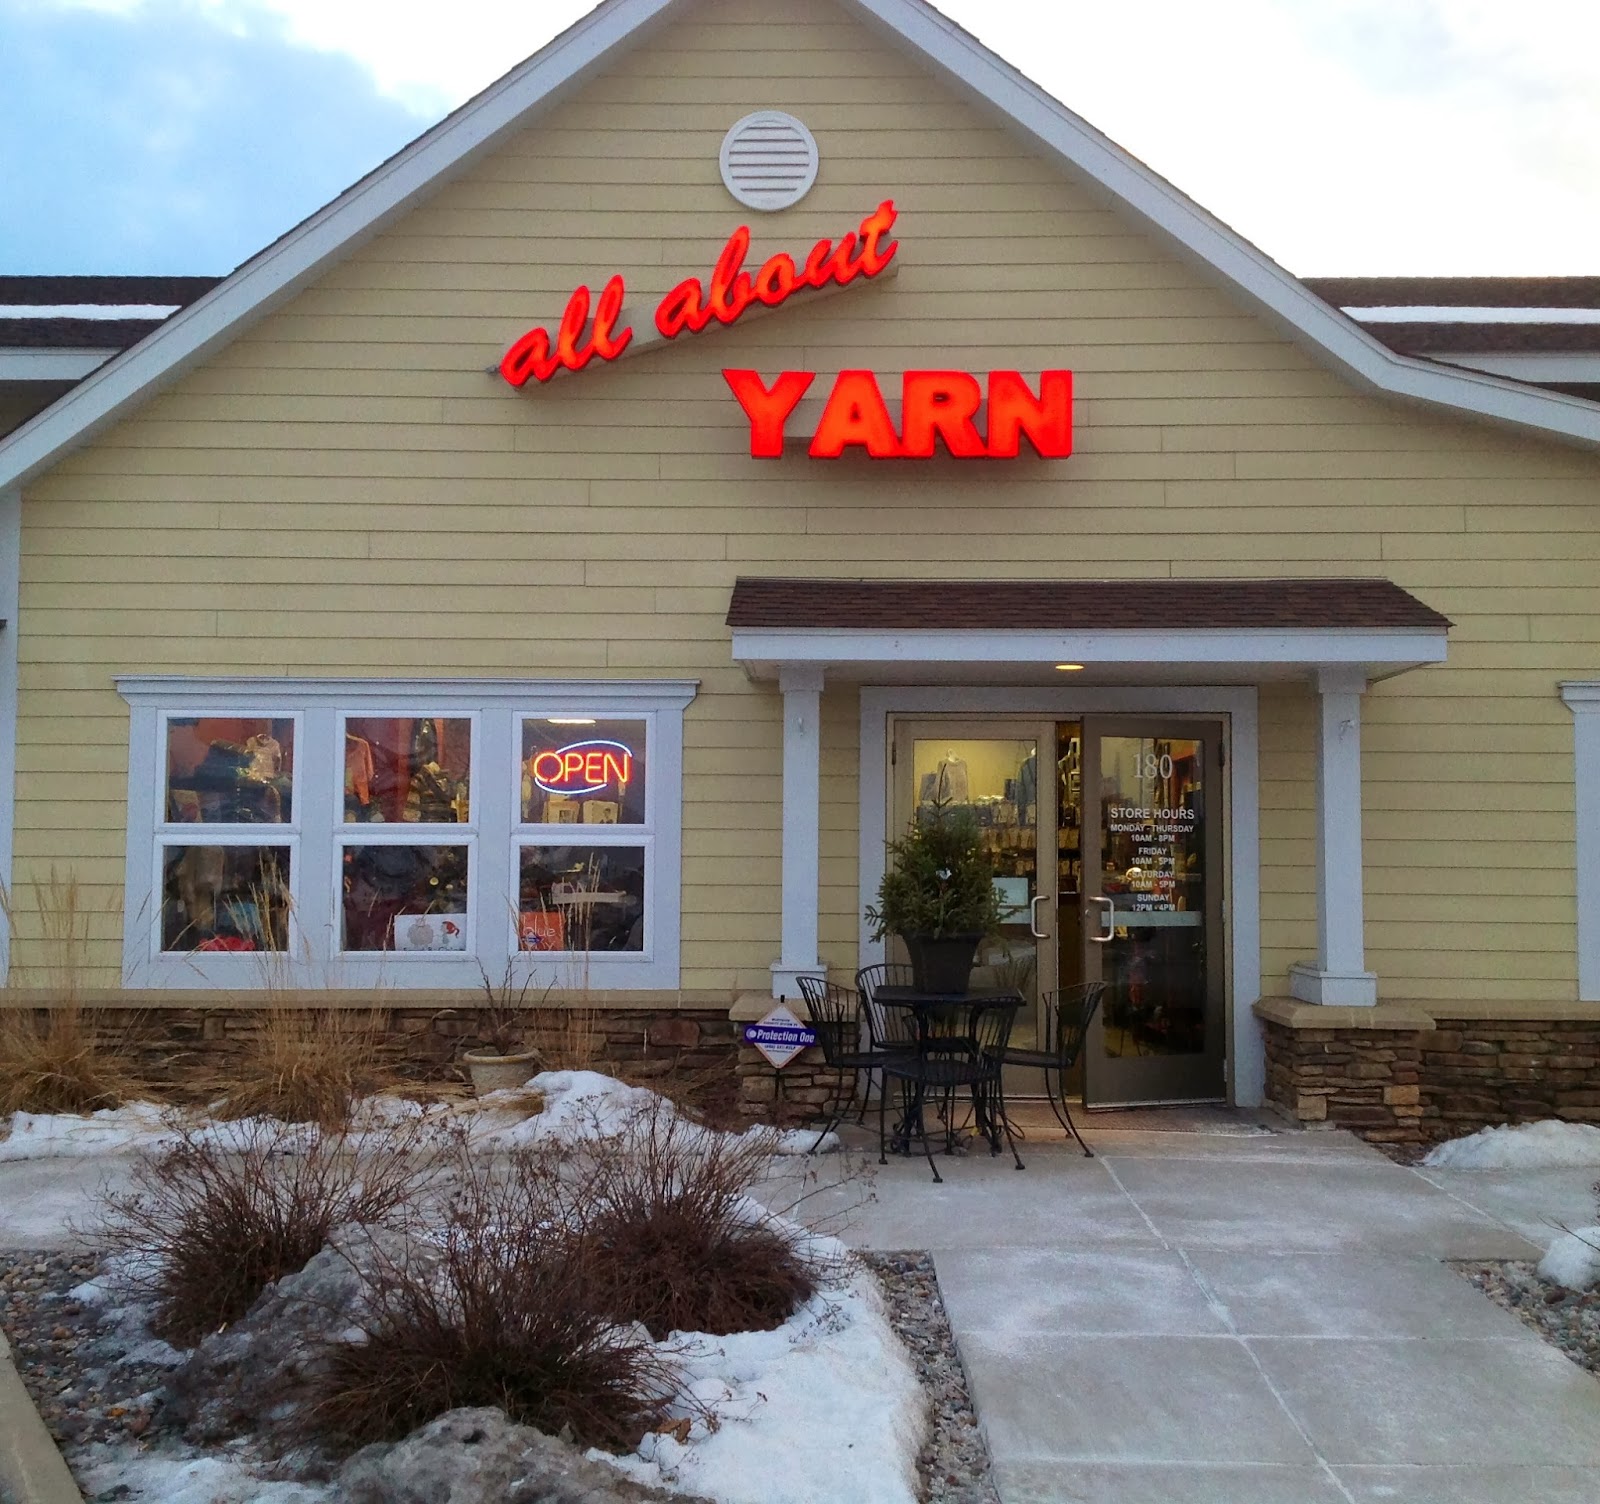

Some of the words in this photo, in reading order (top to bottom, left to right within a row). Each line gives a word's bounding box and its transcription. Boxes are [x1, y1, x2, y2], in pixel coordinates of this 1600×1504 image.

[500, 274, 633, 387] all
[655, 199, 899, 339] about
[722, 369, 1073, 459] YARN
[533, 752, 629, 783] OPEN
[1133, 753, 1173, 779] 180
[1110, 808, 1151, 819] STORE
[1153, 808, 1195, 820] HOURS
[1110, 824, 1145, 832] MONDAY
[1152, 824, 1194, 833] THURSDAY
[1131, 834, 1152, 842] 10AM
[1138, 847, 1167, 855] FRIDAY
[1131, 857, 1152, 865] 10AM
[1132, 870, 1174, 878] SATURDAY
[1131, 880, 1152, 888] 10AM
[1137, 894, 1169, 902] SUNDAY
[1131, 904, 1152, 912] 12PM
[1159, 904, 1175, 912] 4PM
[757, 1029, 798, 1042] Protection
[799, 1032, 815, 1043] One
